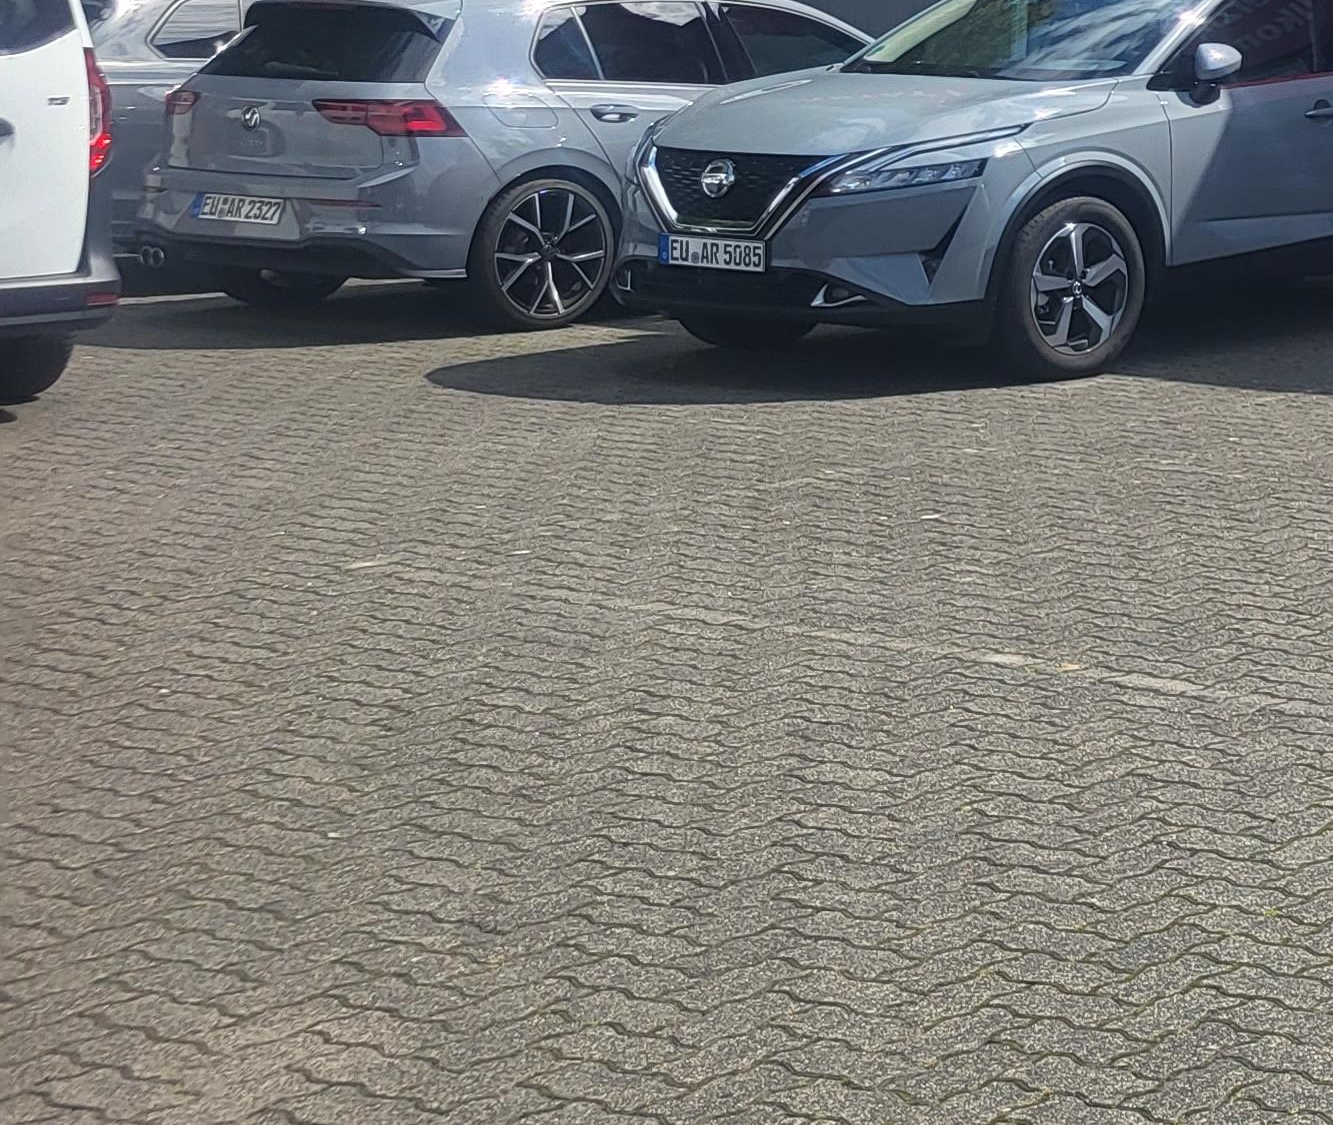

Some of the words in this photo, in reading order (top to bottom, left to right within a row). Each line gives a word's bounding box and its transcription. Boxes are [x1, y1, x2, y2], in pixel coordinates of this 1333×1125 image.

[670, 239, 690, 262] EU
[700, 241, 720, 265] AR
[723, 243, 762, 268] 5085
